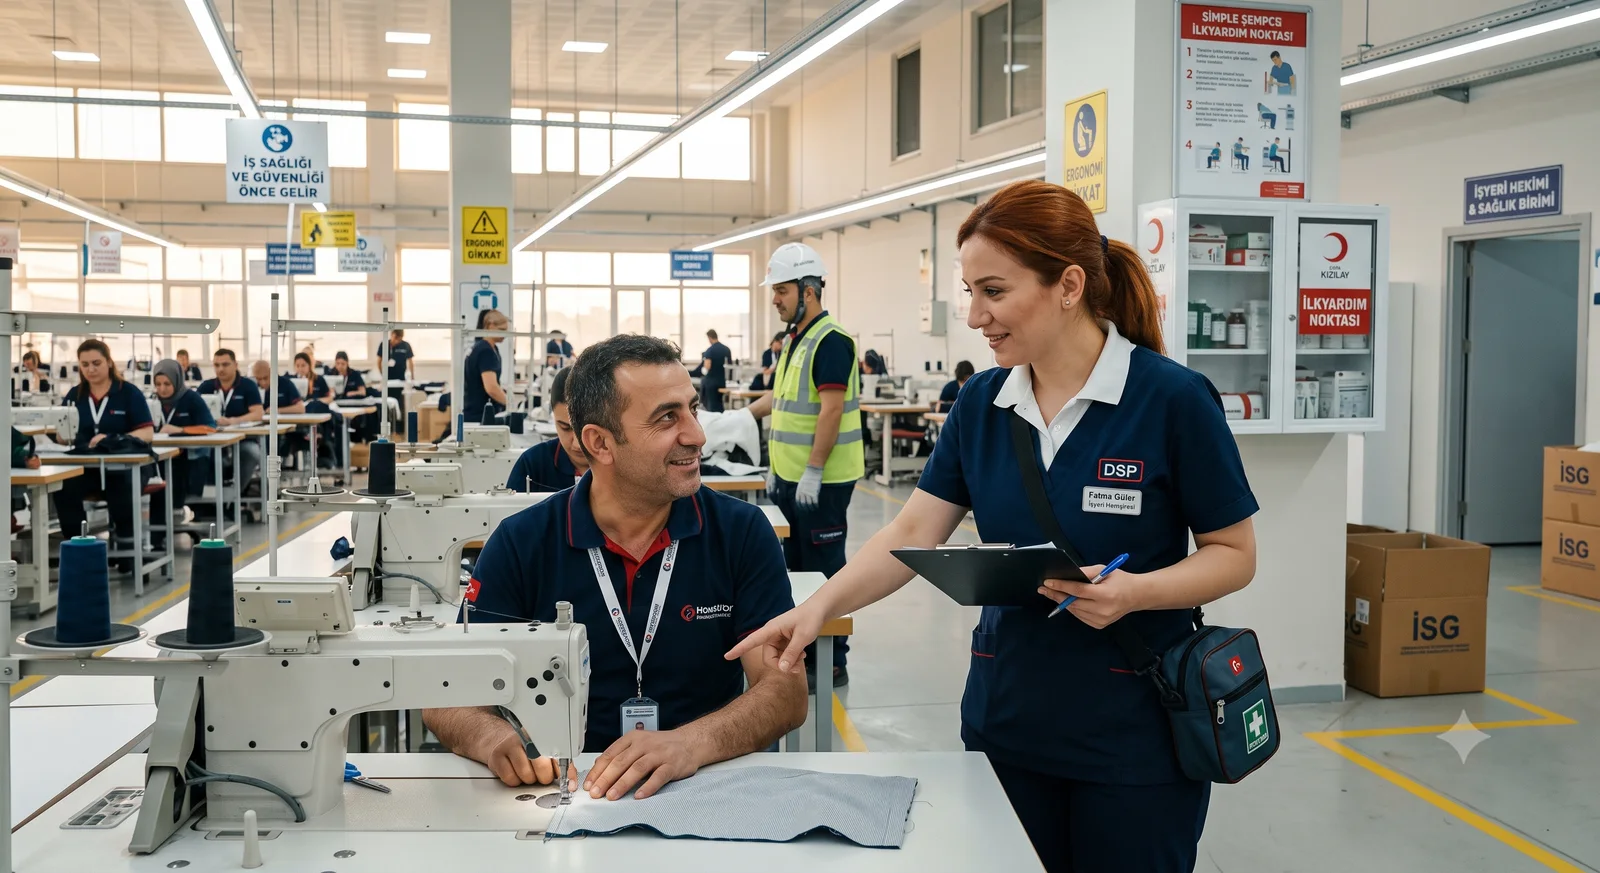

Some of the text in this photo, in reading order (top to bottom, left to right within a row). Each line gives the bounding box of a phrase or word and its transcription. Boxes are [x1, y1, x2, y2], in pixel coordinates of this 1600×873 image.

[1202, 10, 1239, 24] SİMPLE
[1192, 23, 1293, 41] İLKYARDIM NOKTASI
[1187, 47, 1191, 56] 1
[1186, 69, 1192, 79] 2
[1186, 100, 1192, 109] 3
[1186, 140, 1192, 149] 4
[244, 155, 311, 170] İŞ SAĞLIĞI
[1066, 157, 1103, 182] ERGONOMİ
[232, 170, 324, 183] VE GÜVENLİĞİ
[239, 184, 317, 198] ÖNCE GELİR
[1071, 183, 1101, 201] İKKAT
[1474, 174, 1549, 200] İŞYERİ HEKİMİ
[1468, 190, 1555, 215] & SAĞLIK BİRİMİ
[1303, 295, 1366, 310] İLKYARDIM
[1309, 314, 1360, 326] NOKTASI
[1104, 463, 1137, 478] DSP
[1089, 491, 1135, 502] Fatma Güler
[1106, 502, 1135, 510] Hemşiresi
